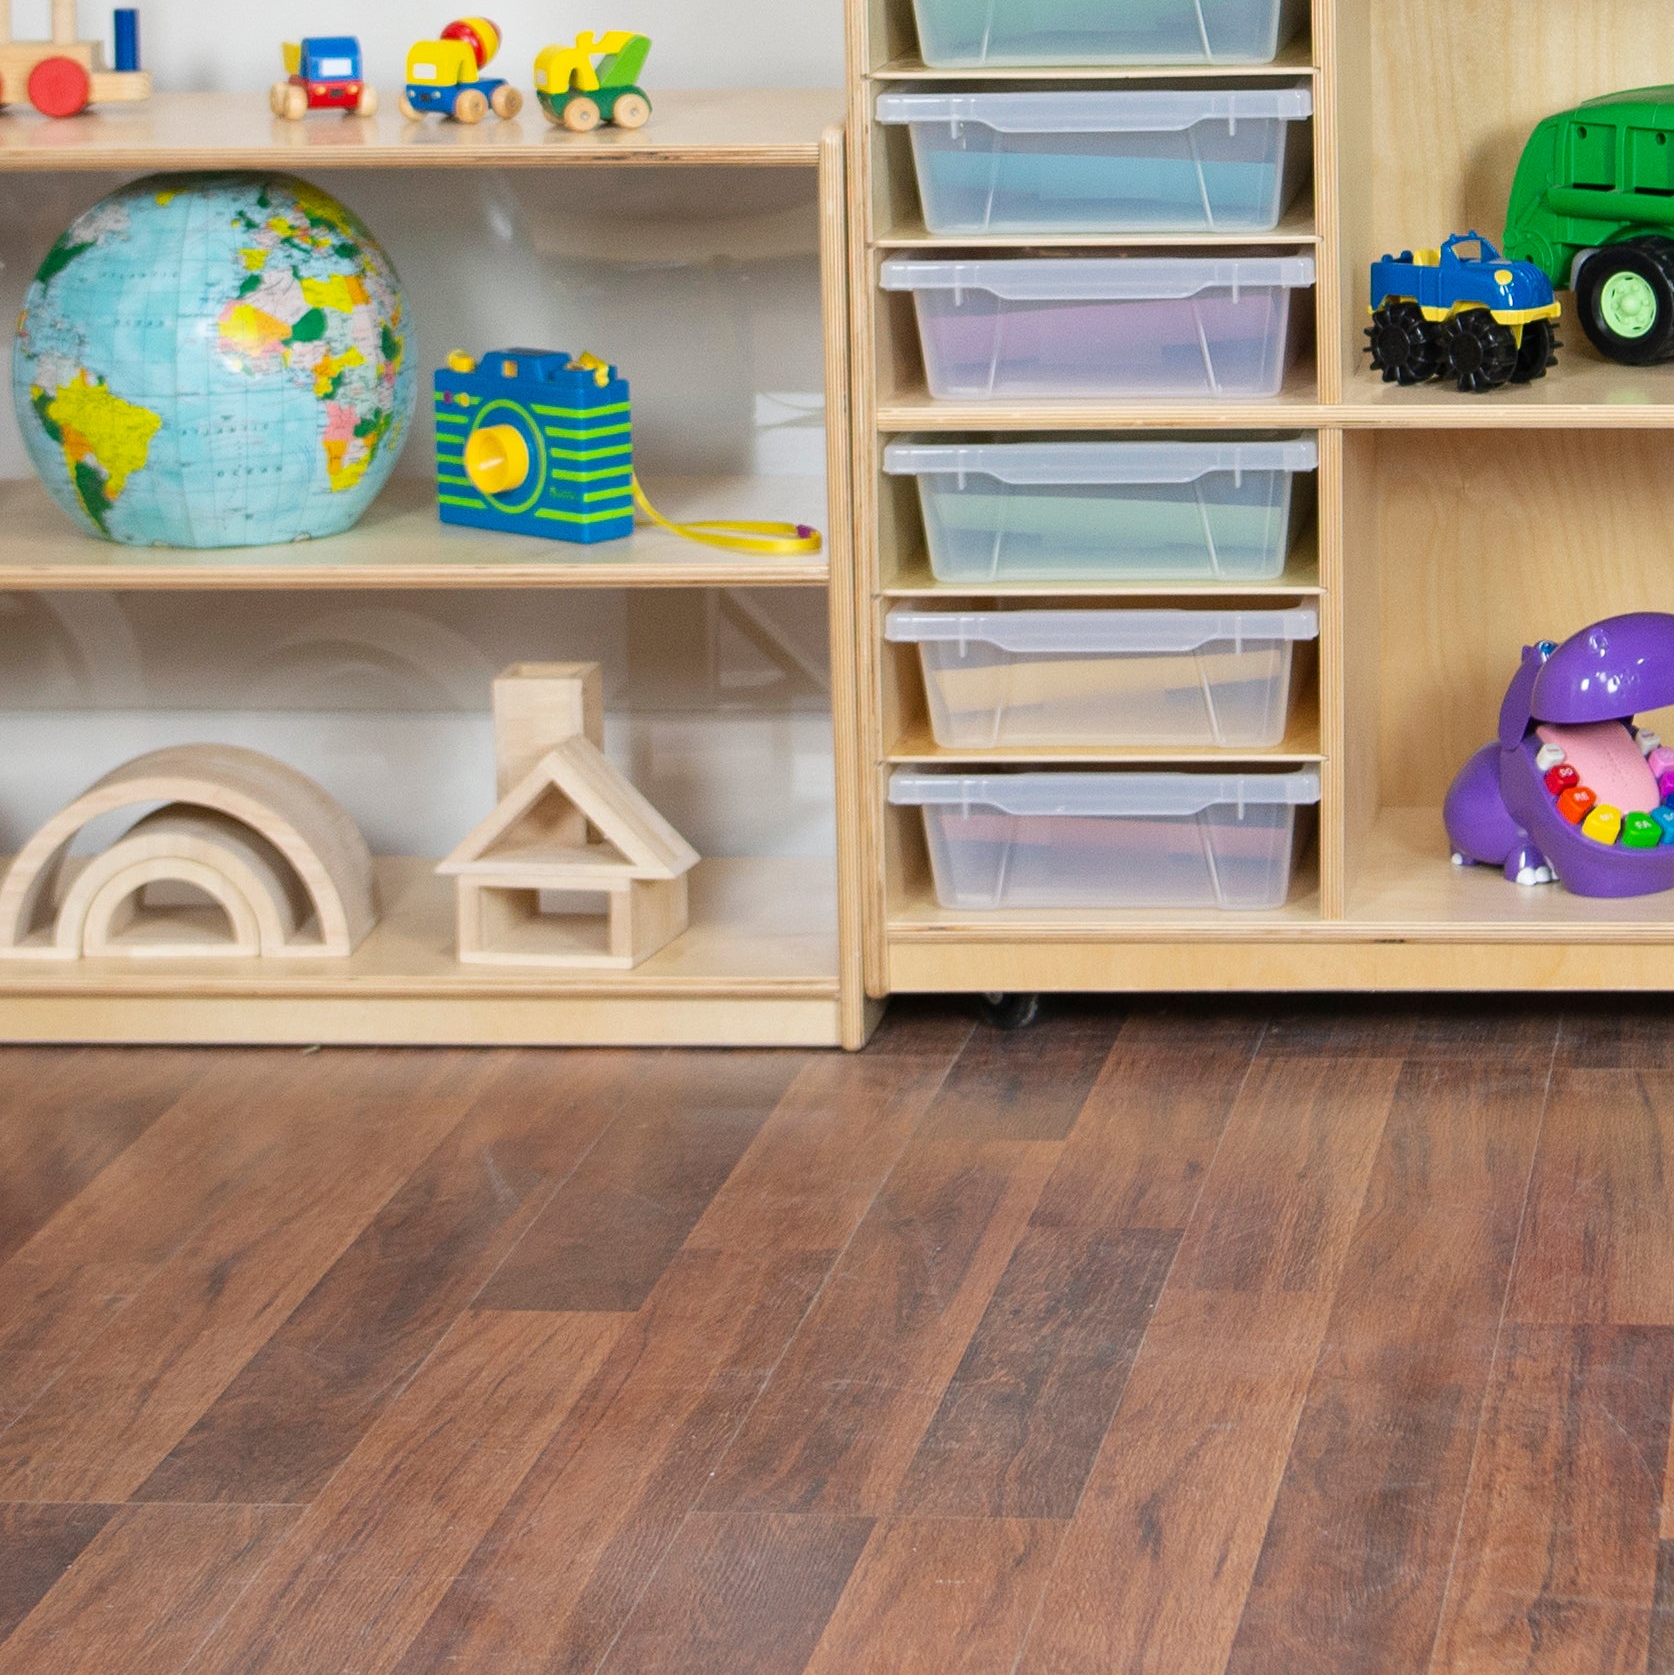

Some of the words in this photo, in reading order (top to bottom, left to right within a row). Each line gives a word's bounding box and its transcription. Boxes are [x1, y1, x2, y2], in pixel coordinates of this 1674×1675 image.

[1559, 767, 1574, 777] DO
[1573, 791, 1590, 802] RE
[1634, 820, 1652, 829] FA
